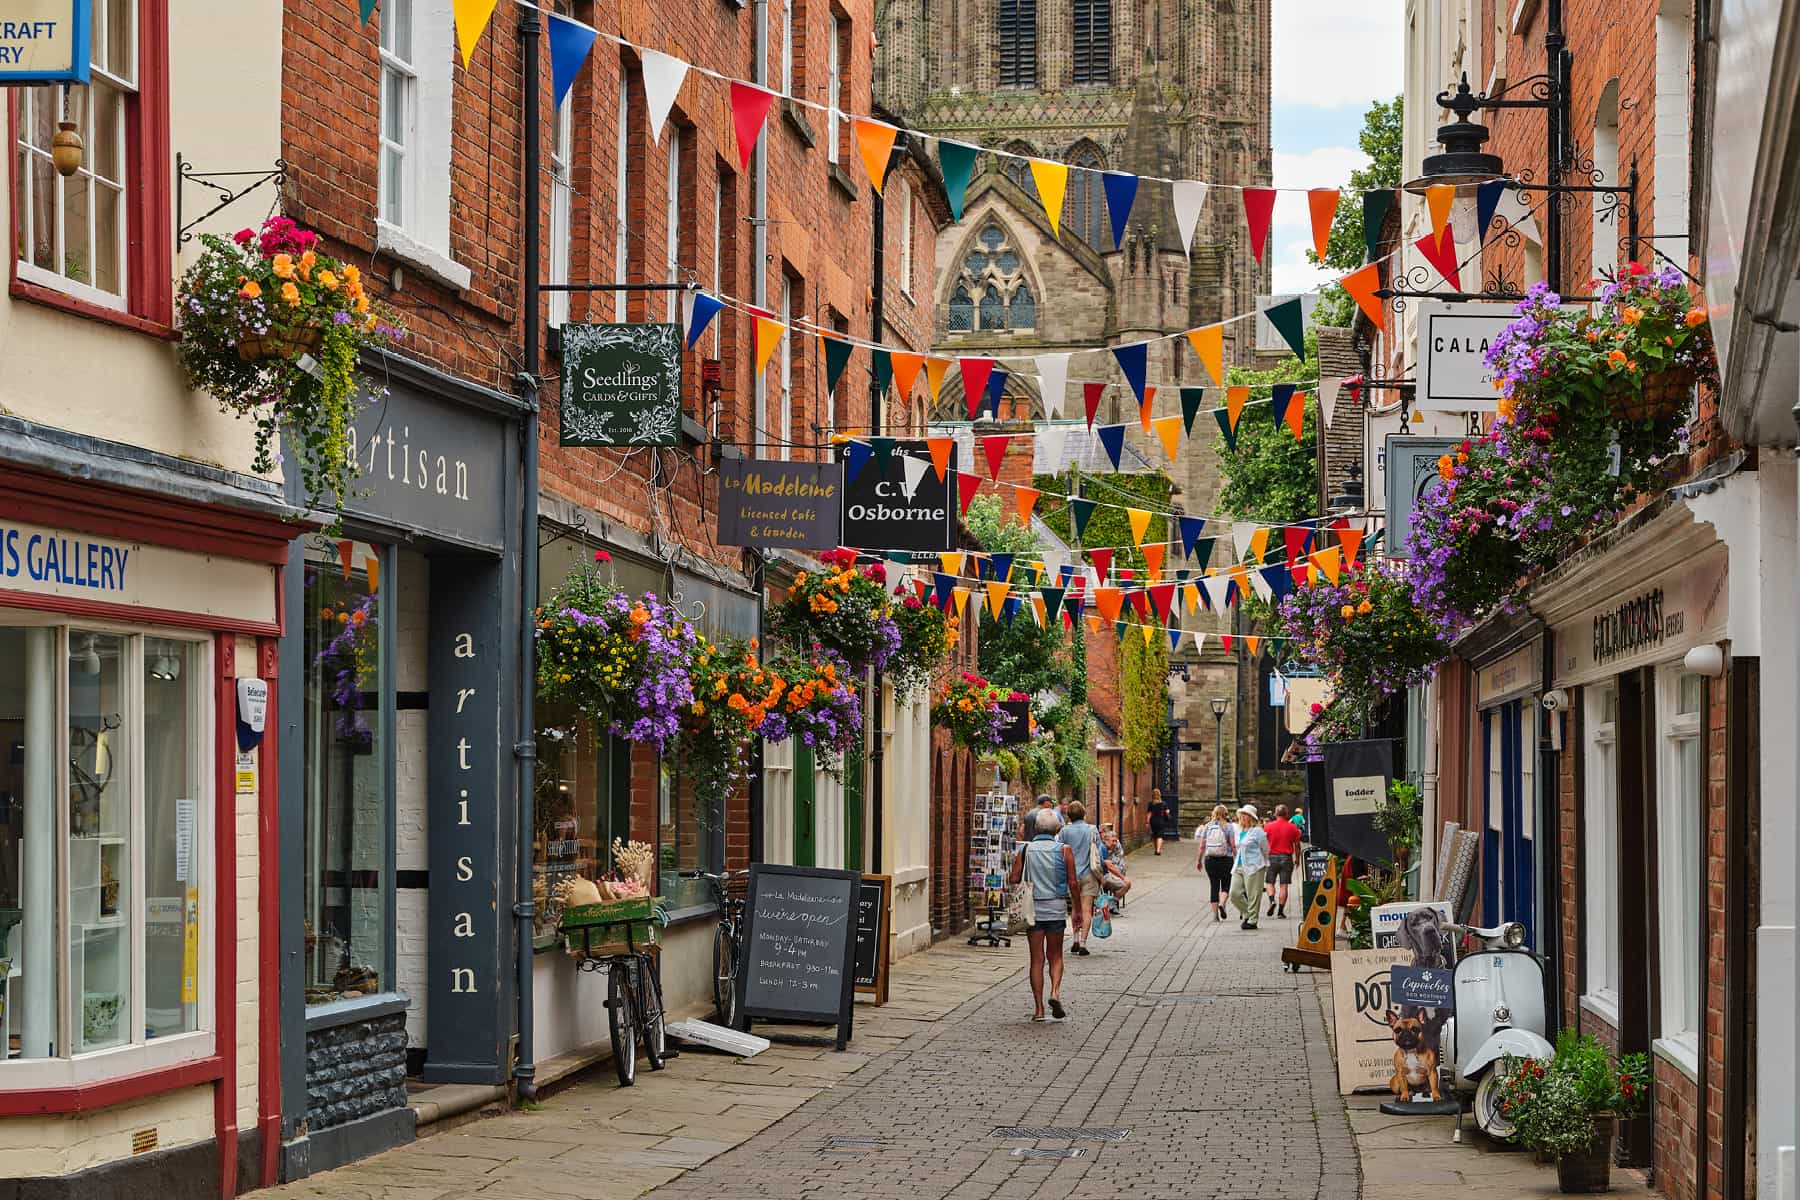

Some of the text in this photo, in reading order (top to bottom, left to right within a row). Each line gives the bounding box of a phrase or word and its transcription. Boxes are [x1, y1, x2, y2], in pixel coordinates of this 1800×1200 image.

[0, 22, 57, 39] RAFT
[582, 367, 658, 391] Seedlings
[582, 390, 658, 402] CARDS & GIFTS
[346, 424, 469, 501] artisan
[742, 472, 835, 498] Madeleine
[740, 506, 788, 521] Licensed
[848, 504, 945, 521] Osborne
[750, 525, 805, 539] & Garden
[26, 534, 128, 591] GALLERY
[450, 631, 478, 993] artisan
[1402, 976, 1450, 993] Capooches
